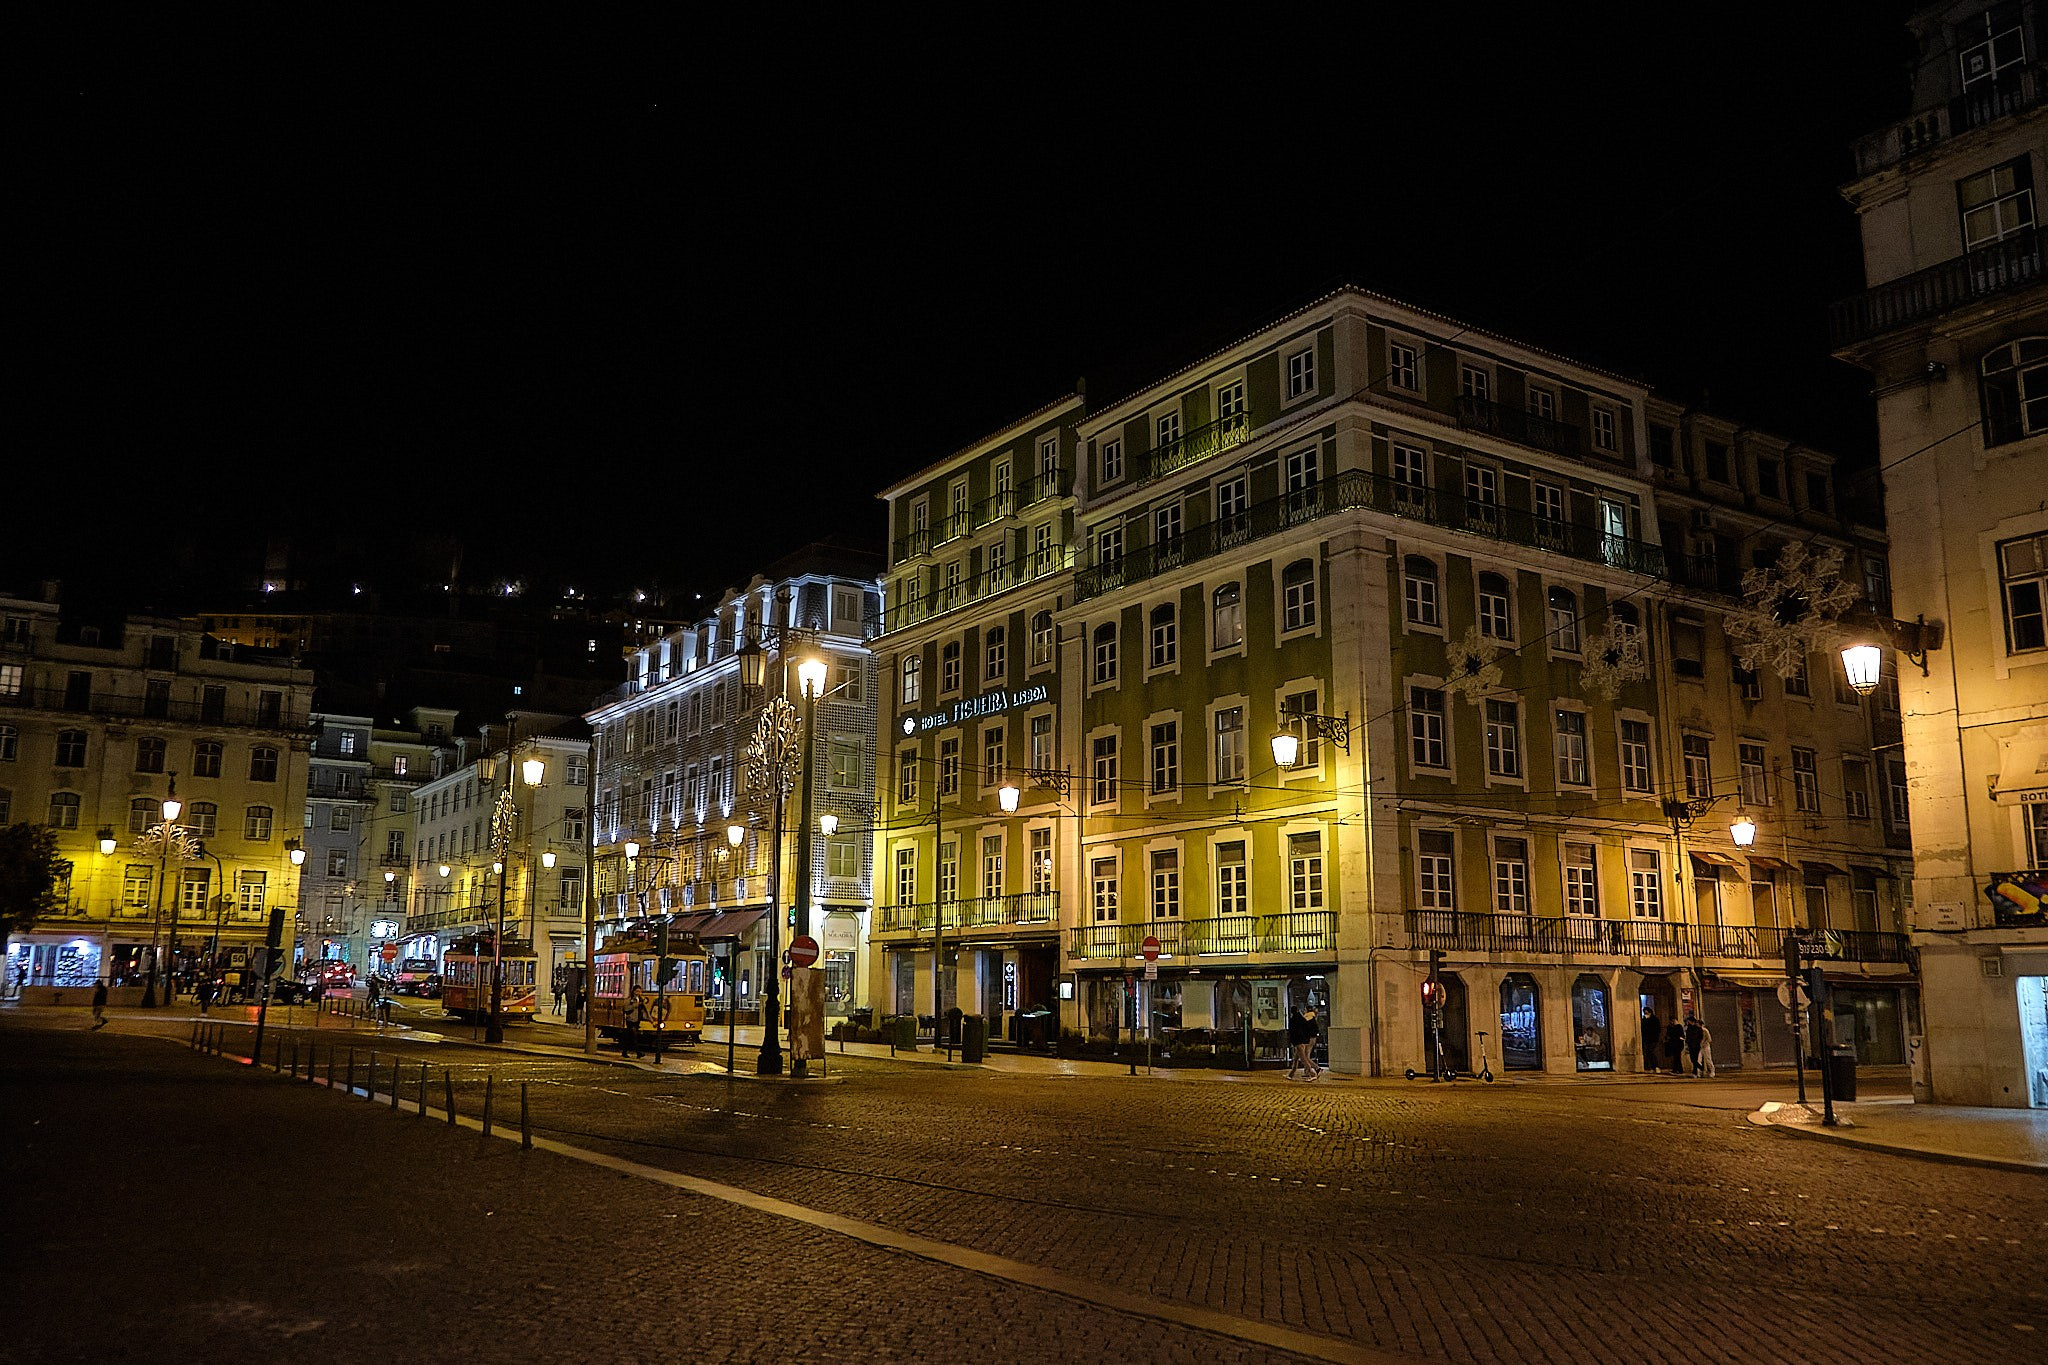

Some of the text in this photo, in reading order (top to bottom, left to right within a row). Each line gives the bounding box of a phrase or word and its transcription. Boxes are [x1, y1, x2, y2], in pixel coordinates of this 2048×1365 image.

[921, 686, 1047, 730] HOTEL FIGUEIRA LISBOA
